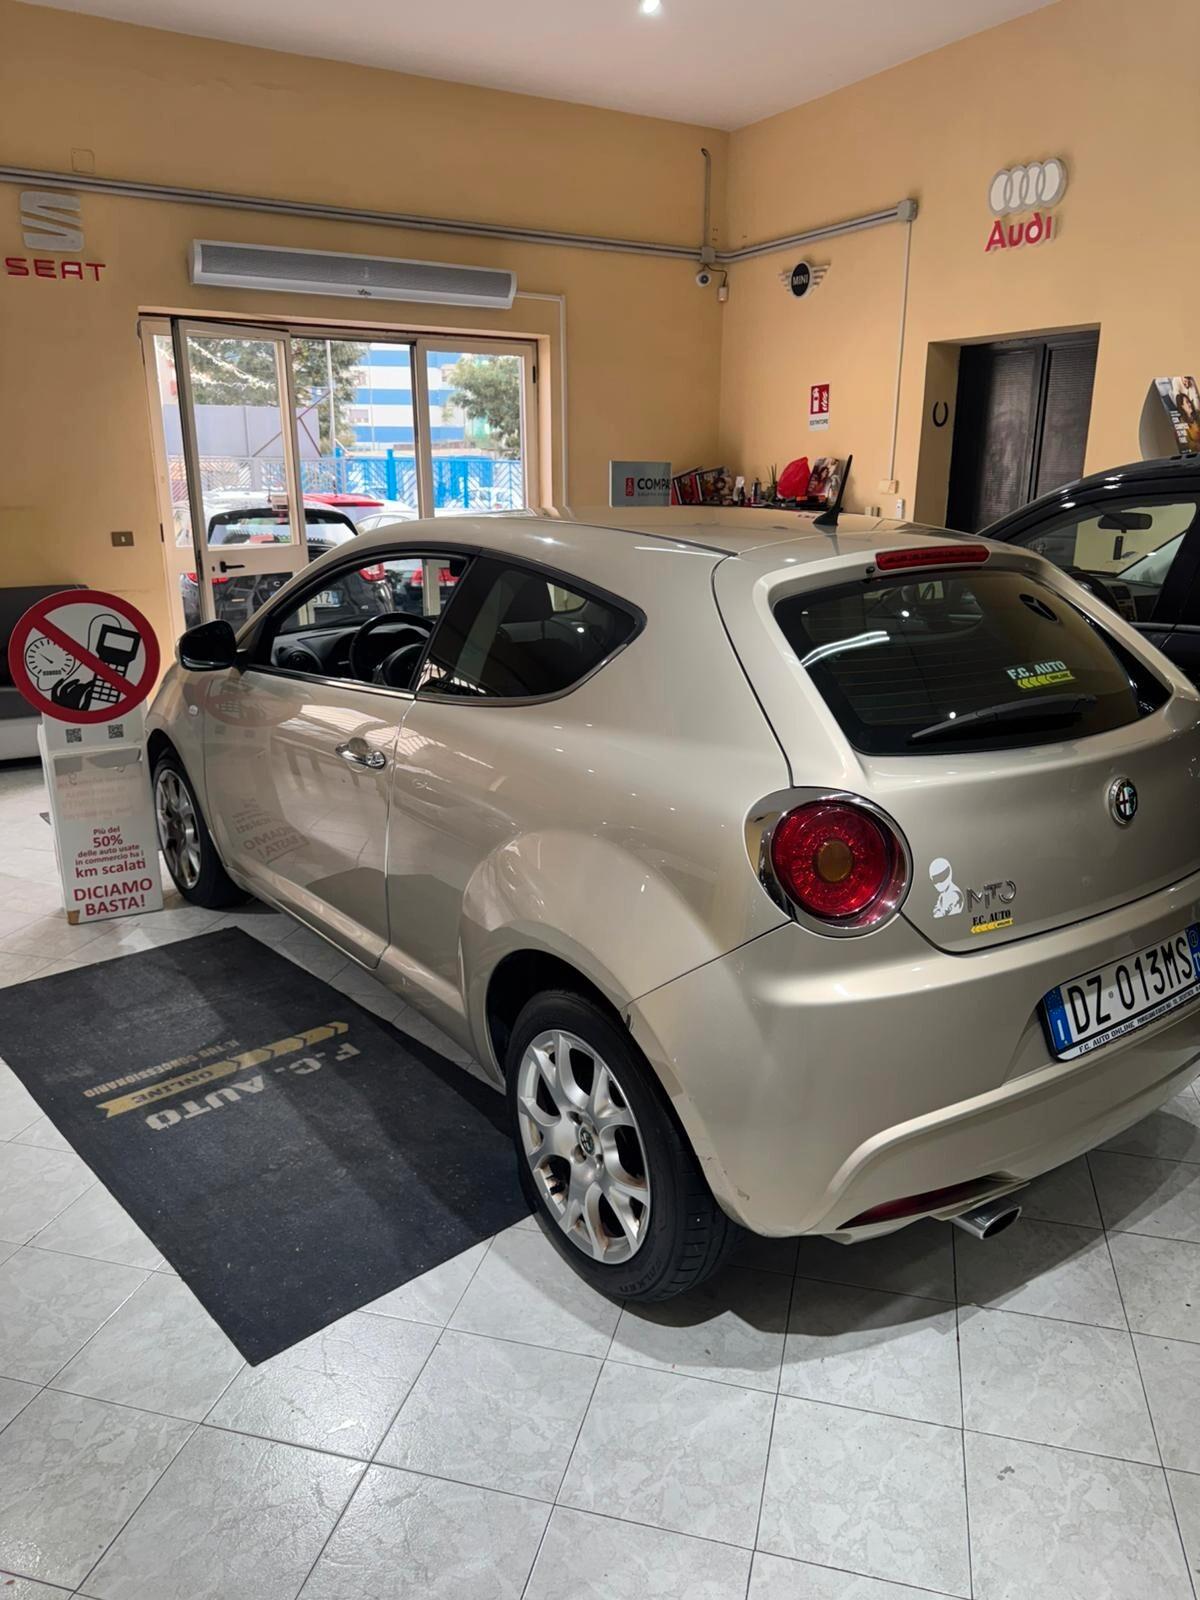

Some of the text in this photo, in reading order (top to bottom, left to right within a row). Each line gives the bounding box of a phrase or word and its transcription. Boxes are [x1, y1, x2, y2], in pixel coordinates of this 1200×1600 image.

[984, 211, 1053, 253] Audi
[5, 256, 106, 282] SEAT
[792, 273, 810, 287] MINI
[1034, 660, 1067, 675] AUTO
[93, 825, 121, 836] Più del
[93, 834, 123, 848] 50%
[78, 844, 140, 858] delle auto usate
[85, 853, 128, 865] commercio
[129, 850, 140, 858] ha
[75, 858, 146, 879] km scalati
[73, 877, 153, 902] DICIAMO
[85, 894, 146, 917] BASTA!
[989, 909, 1011, 922] AUTO
[1092, 1033, 1111, 1048] AUTO
[1110, 1021, 1136, 1038] ONLINE
[198, 1044, 226, 1059] TUO
[82, 1054, 199, 1098] CONCESSIONARIO
[131, 1069, 214, 1105] ONLINE
[144, 1075, 265, 1131] AUTO
